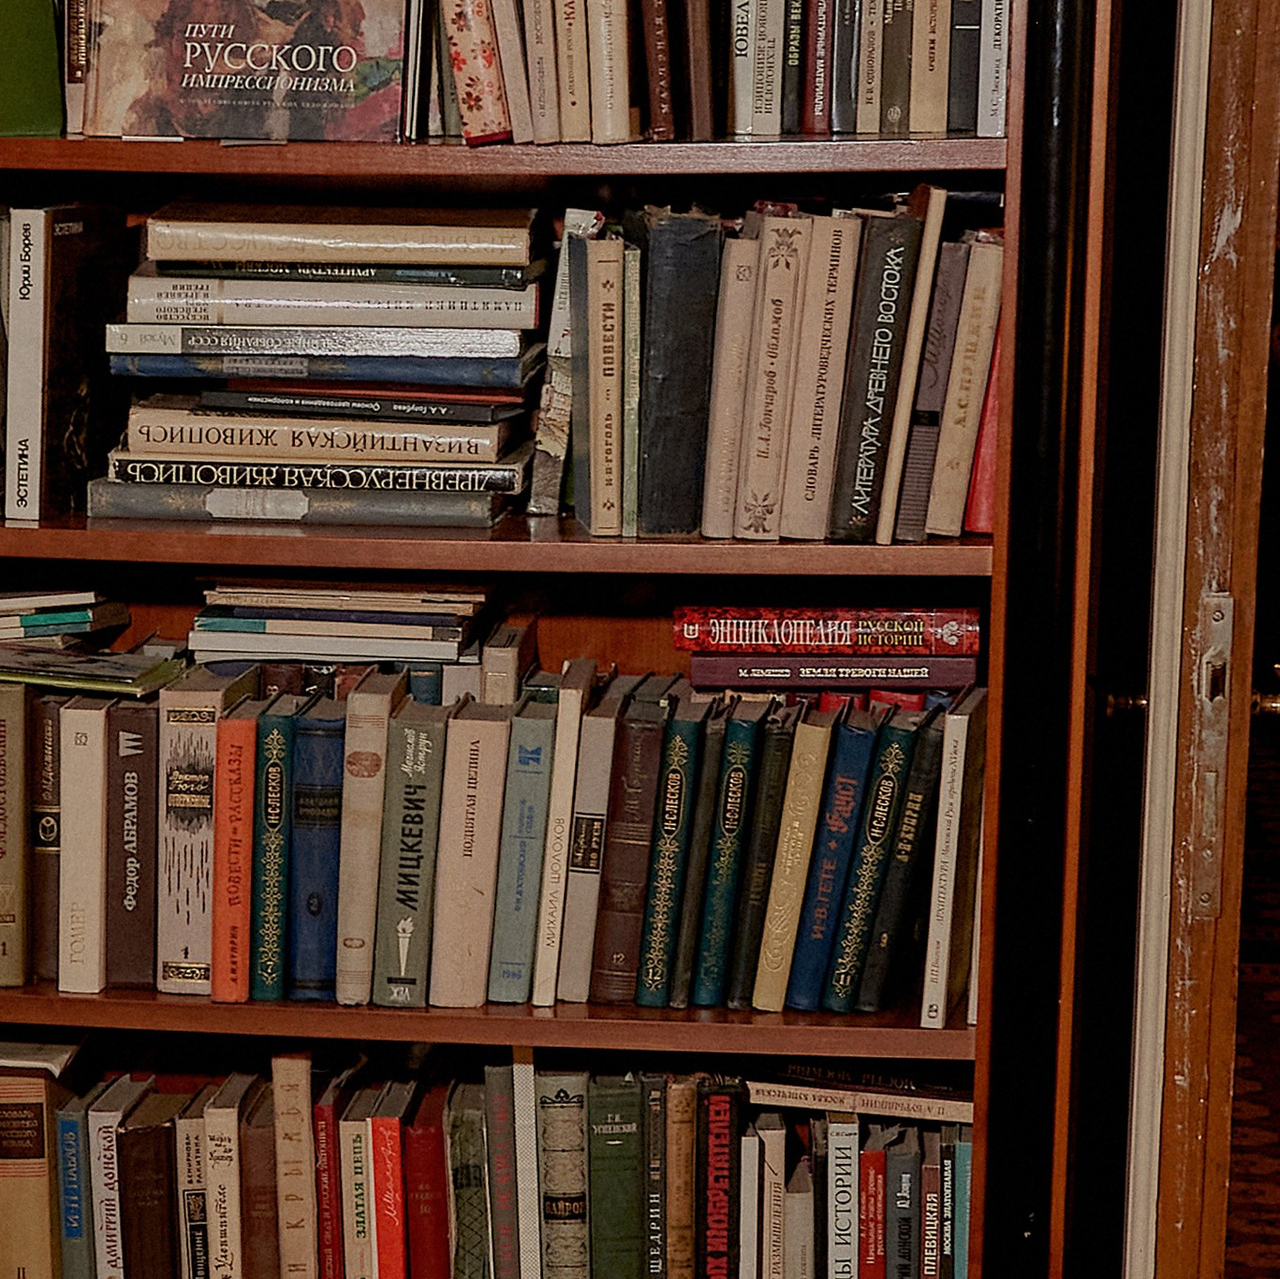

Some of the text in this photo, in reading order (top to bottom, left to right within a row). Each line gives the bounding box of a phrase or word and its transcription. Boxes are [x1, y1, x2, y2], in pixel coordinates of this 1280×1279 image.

[183, 43, 358, 73] РУССКОГО
[184, 23, 236, 39] ПУТИ
[180, 73, 356, 93] ИМПРЕССИОНИЗМА
[19, 222, 33, 300] Юрий Борев
[603, 300, 616, 378] ПОВЕСТИ
[803, 435, 821, 502] СЛОВАРЬ
[826, 227, 843, 295] ТЕРМИНОВ
[850, 245, 905, 515] ЛИТЕРАТУРА ДРЕВНЕГО ВОСТОКА
[16, 437, 30, 508] ЭСТЕТИКА
[126, 462, 492, 492] ДРЕВНЕРУССКАЯ ЖИВОПИСЬ
[138, 424, 480, 455] ВИЗАНТИЙСКАЯ ЖИВОПИСЬ
[709, 618, 853, 648] ЭНЦИКЛОПЕДИЯ
[122, 769, 141, 912] Федор АБРАМОВ
[396, 783, 426, 911] МИЦКЕВИЧ
[545, 817, 565, 948] МИХАИЛ ШОЛОХОВ
[354, 1180, 367, 1240] ЗЛАТАЯ
[648, 1192, 663, 1274] ЩЕДРИН
[833, 1145, 853, 1246] ИСТОРИИ
[924, 1192, 938, 1274] ПЛЕВИЦКАЯ
